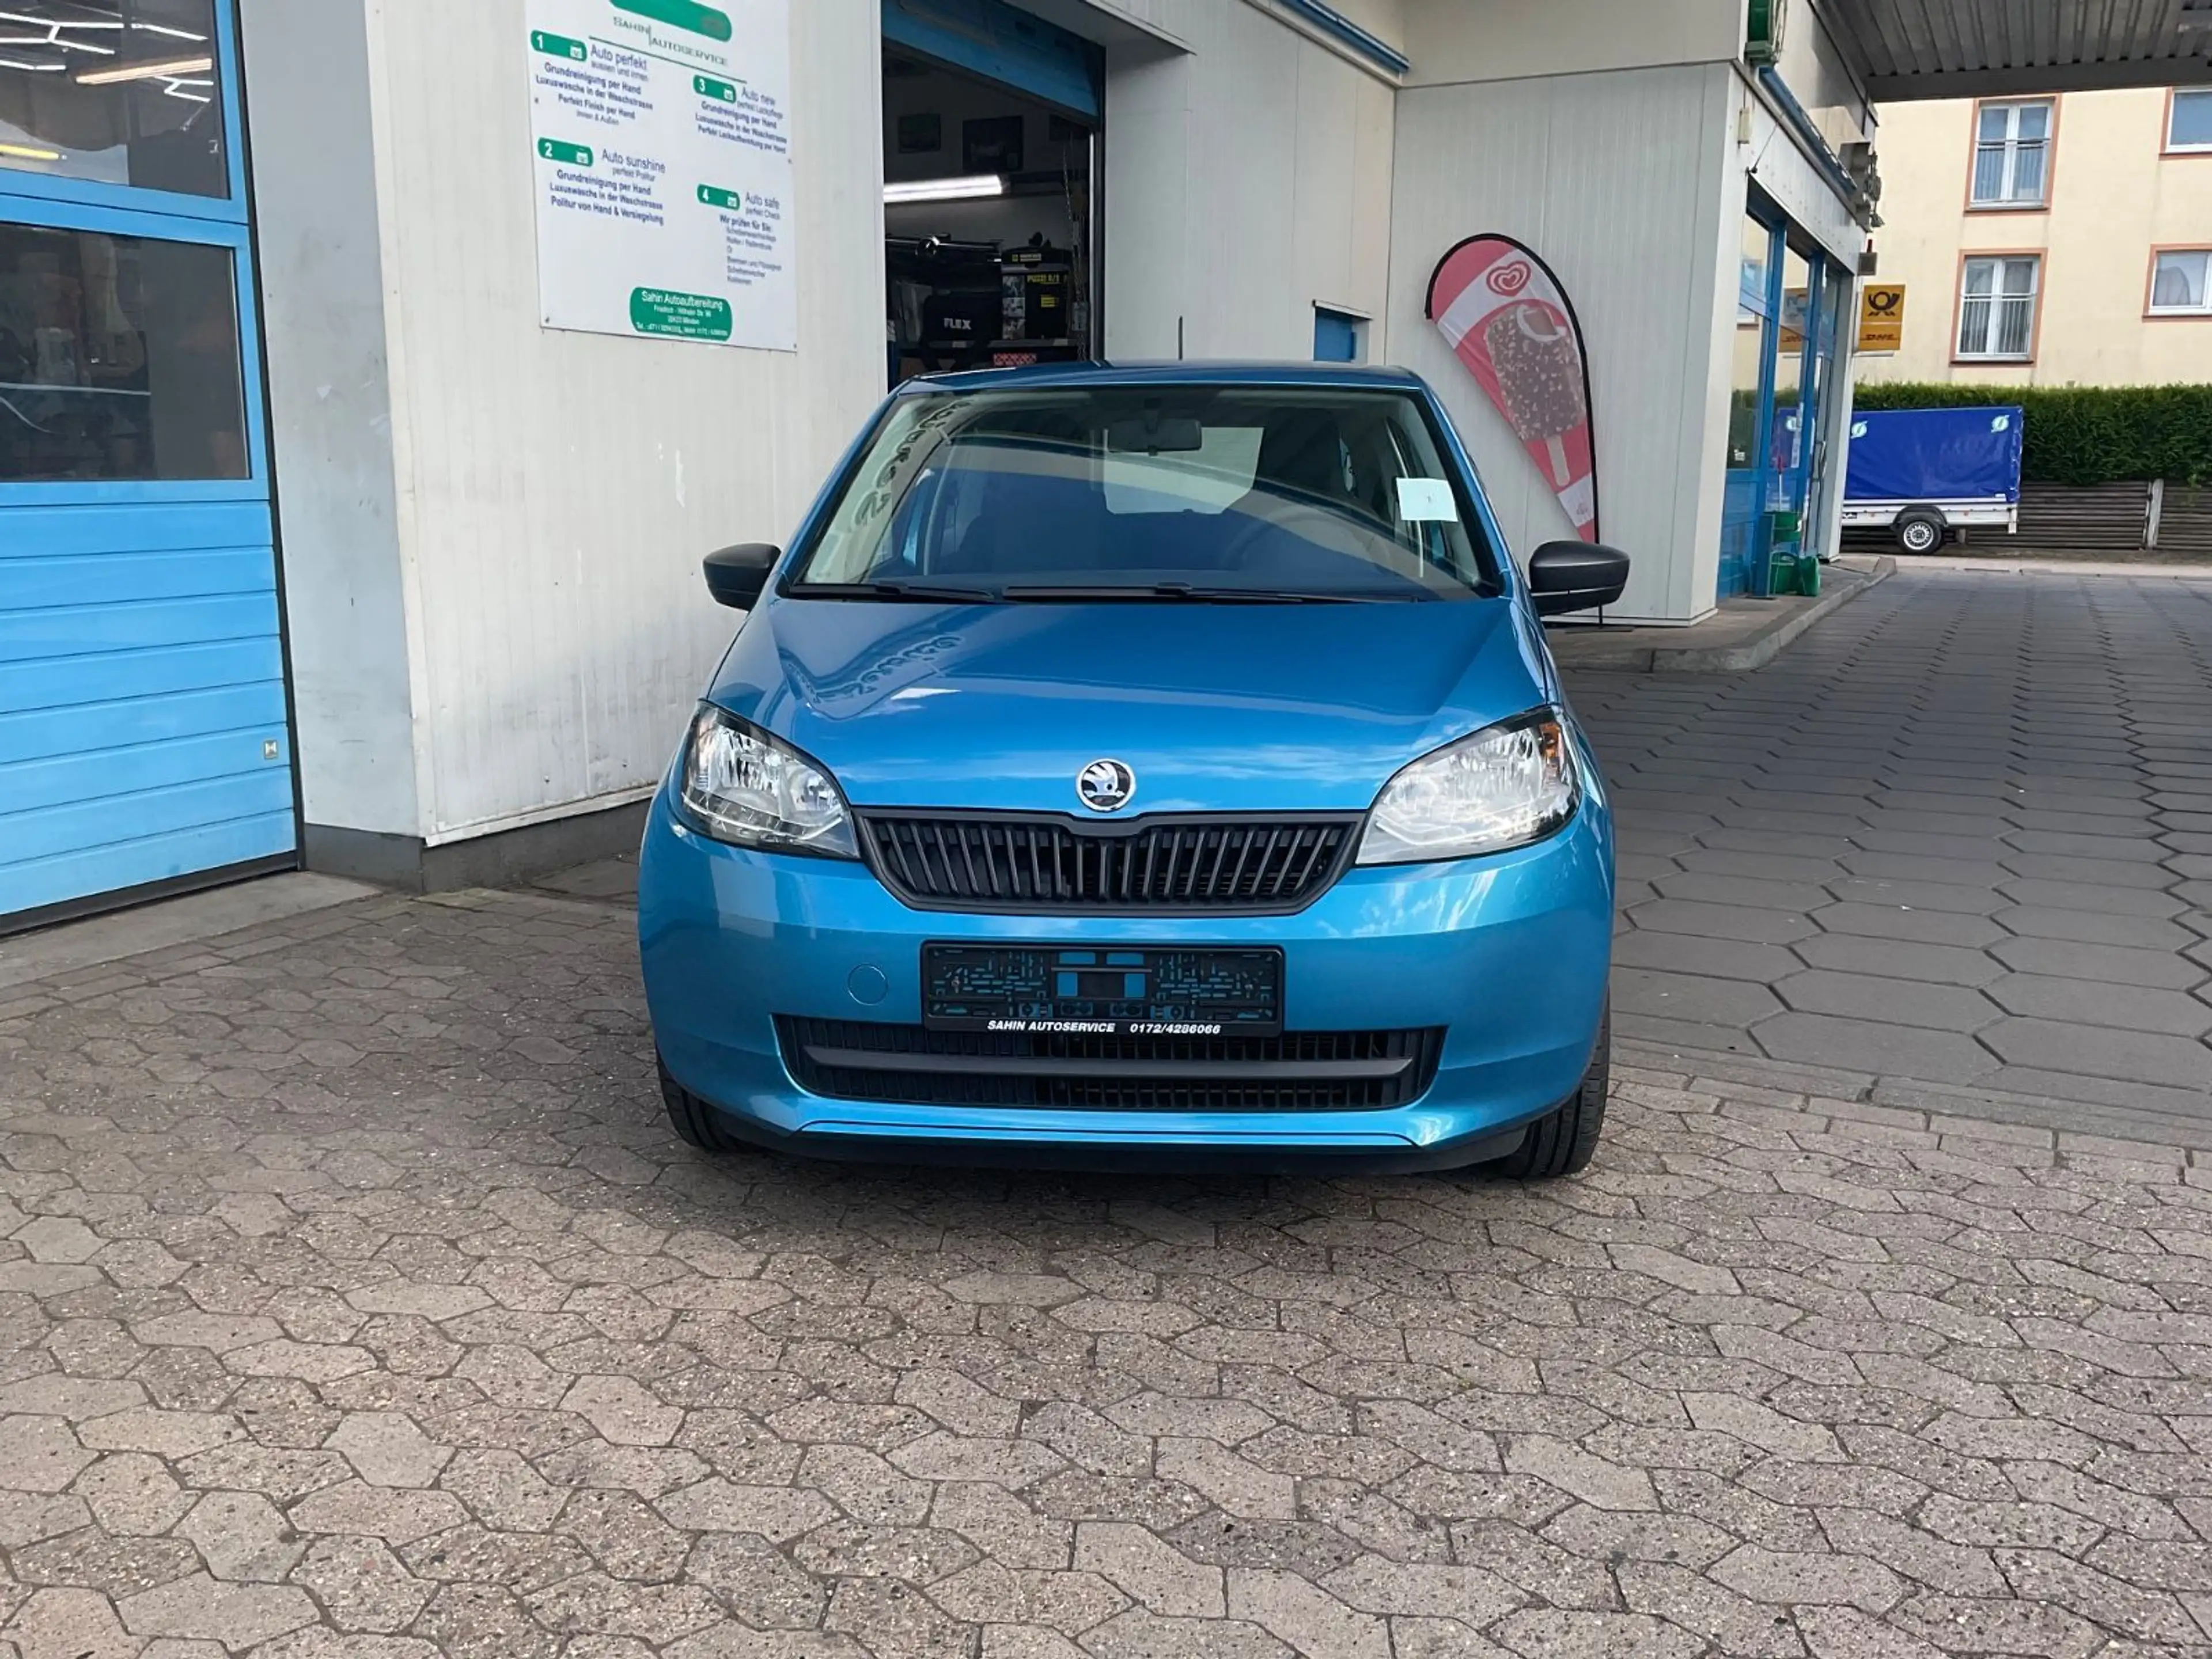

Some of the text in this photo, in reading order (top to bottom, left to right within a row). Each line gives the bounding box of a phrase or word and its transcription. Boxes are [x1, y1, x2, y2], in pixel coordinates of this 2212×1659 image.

[536, 34, 543, 50] 1
[590, 44, 647, 70] Auto perfekt
[544, 62, 641, 94] Grundreinigung per Hand
[699, 78, 706, 92] 3
[586, 85, 593, 95] in
[585, 99, 605, 111] Finish
[619, 108, 635, 119] Hand
[544, 142, 552, 157] 2
[602, 149, 666, 174] Auto sunshine
[557, 169, 651, 196] Grundreinigung per Hand
[599, 191, 605, 199] in
[607, 192, 618, 202] der
[702, 188, 709, 202] 4
[745, 192, 779, 210] Auto safe
[551, 195, 664, 227] Politur von Hand & Versiegelung
[642, 290, 723, 312] Sahin Autoaufbereitung
[944, 317, 972, 330] FLEX
[987, 1020, 1222, 1035] SAHIN AUTOSERVICE 0172/4286066
